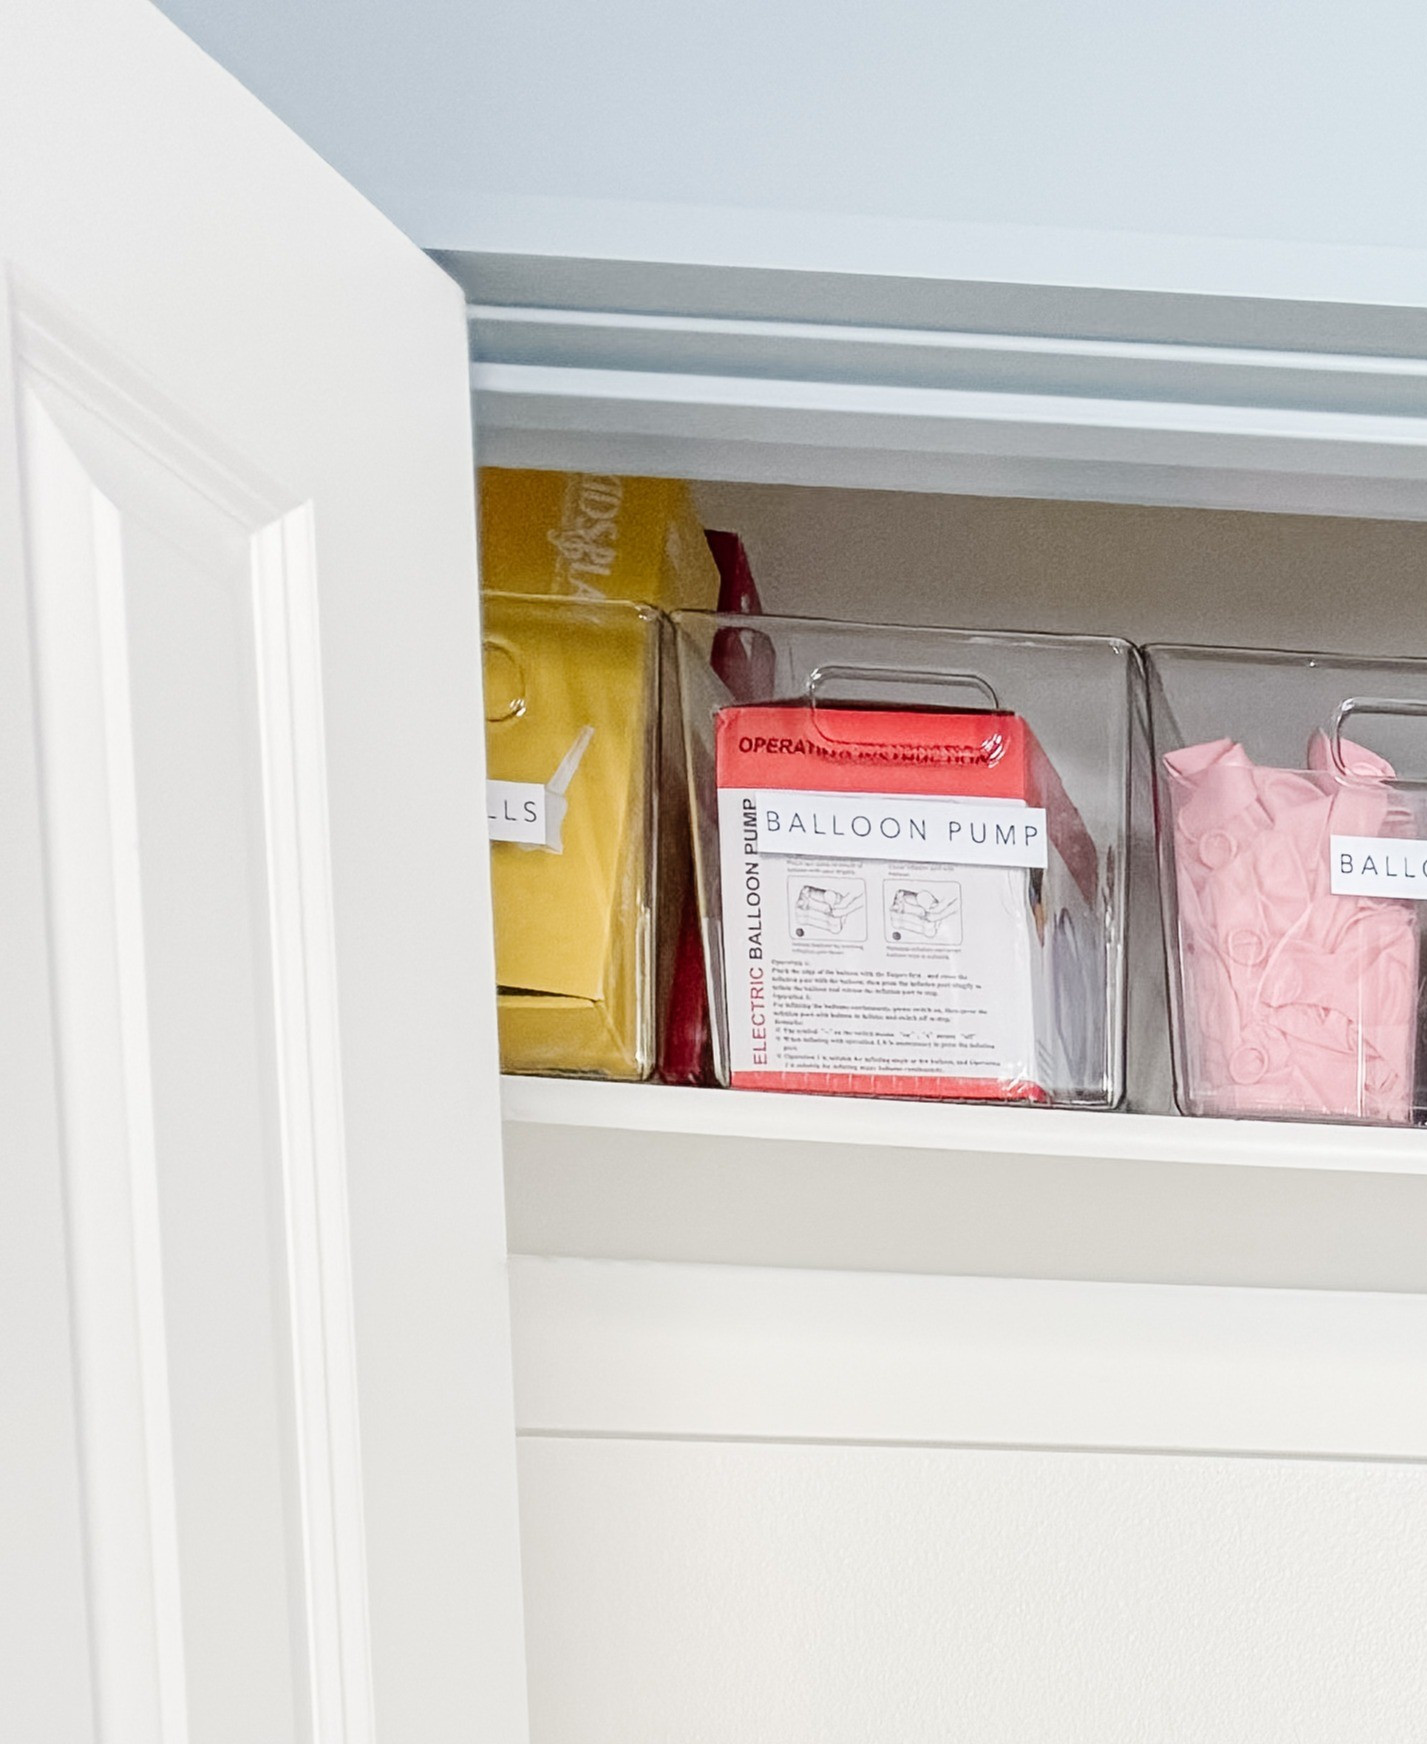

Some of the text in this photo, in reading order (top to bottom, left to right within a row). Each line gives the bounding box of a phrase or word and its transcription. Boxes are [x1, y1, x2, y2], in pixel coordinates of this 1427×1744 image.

[766, 810, 1038, 847] BALLOON PUMP
[742, 798, 768, 1065] ELECTRIC BALLOON PUMP
